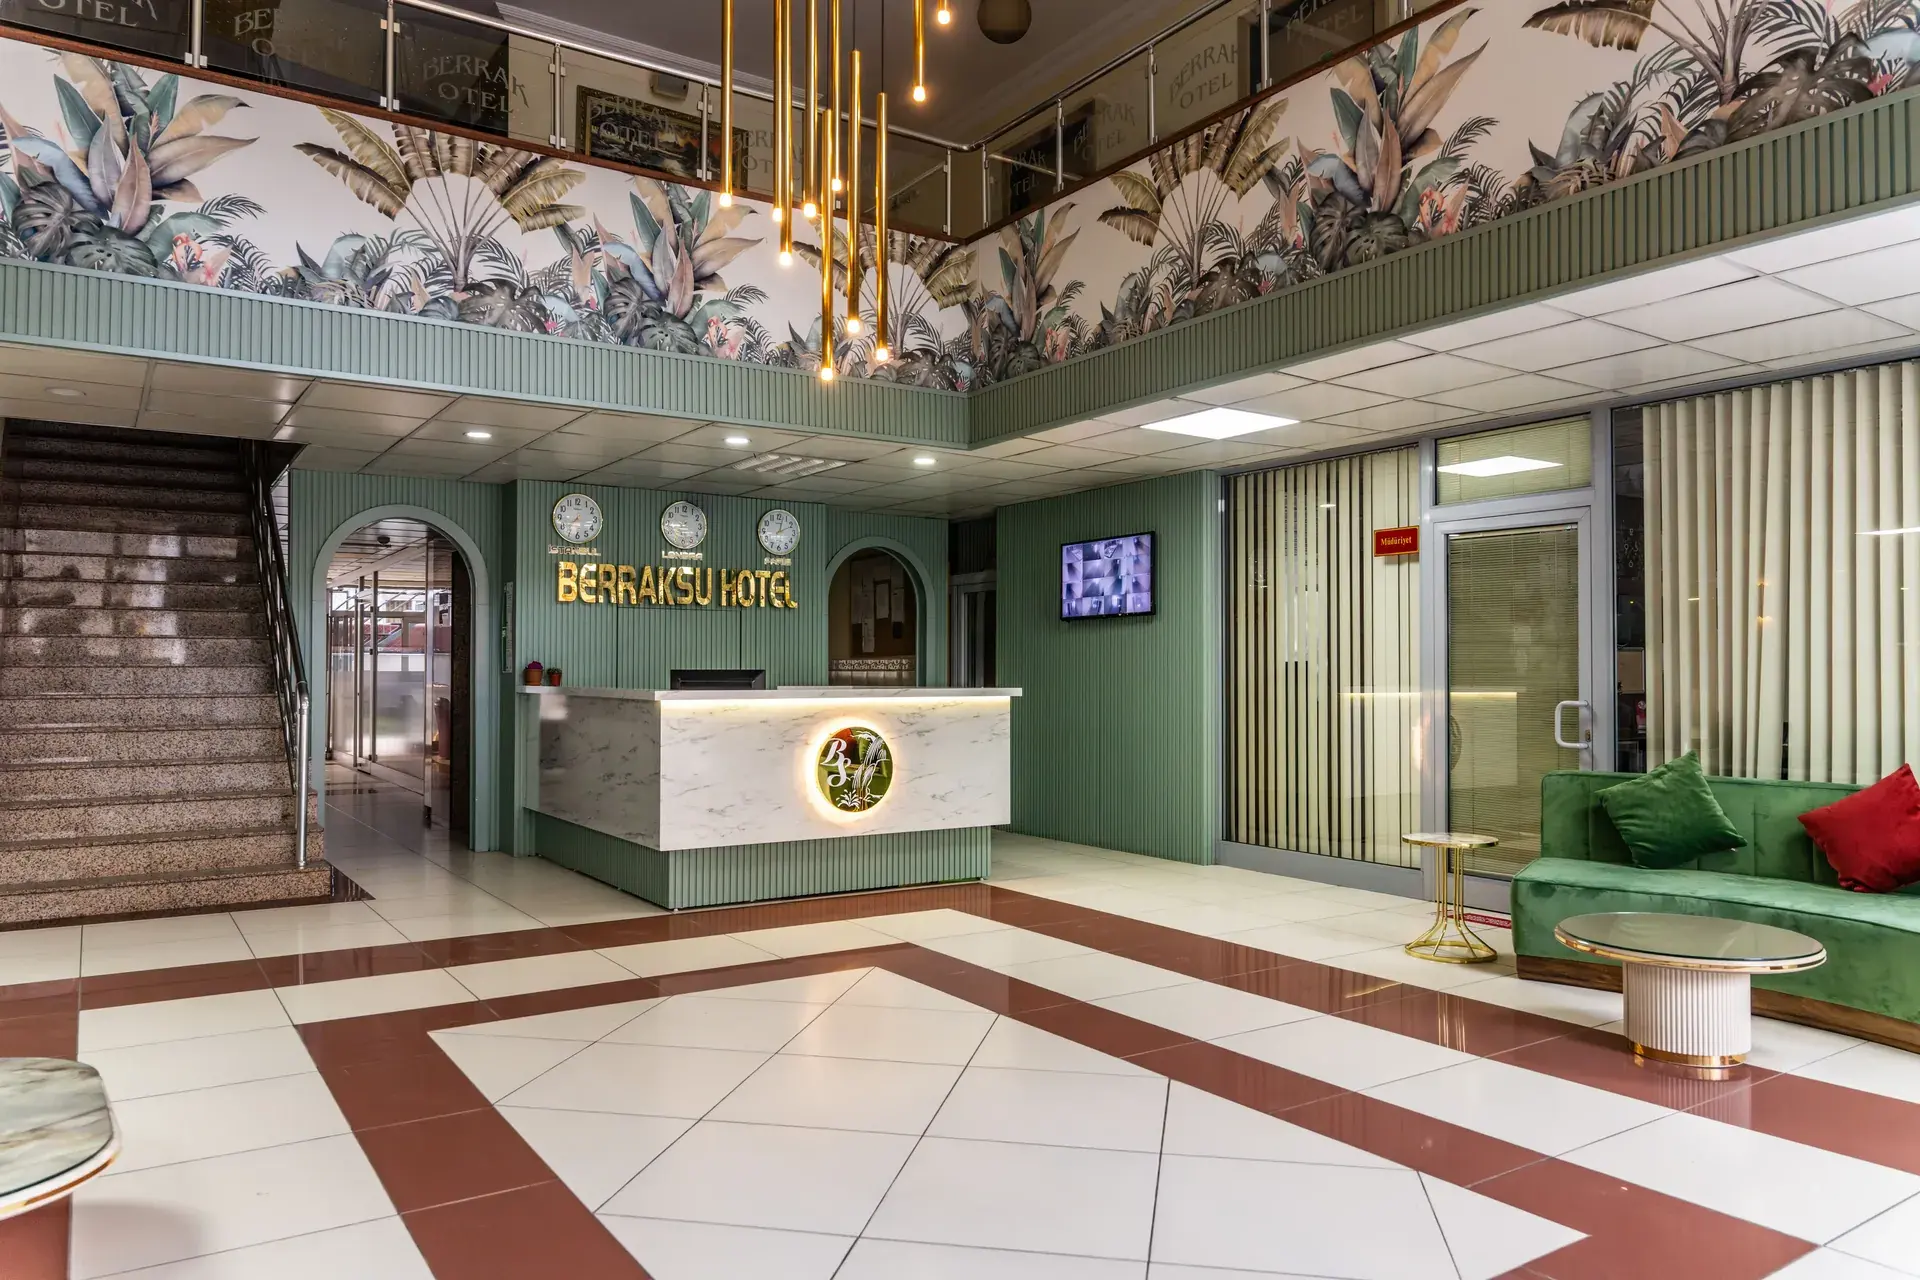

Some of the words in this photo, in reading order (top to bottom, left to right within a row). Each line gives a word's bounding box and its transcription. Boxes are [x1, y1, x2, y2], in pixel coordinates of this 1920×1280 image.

[422, 54, 530, 109] BERRAK
[438, 82, 515, 113] OTEL
[1180, 73, 1233, 109] OTEL
[1012, 172, 1040, 196] TEL
[1381, 536, 1412, 546] Müdüriyet
[557, 561, 712, 607] BERRAKSU
[720, 568, 799, 609] HOTEL
